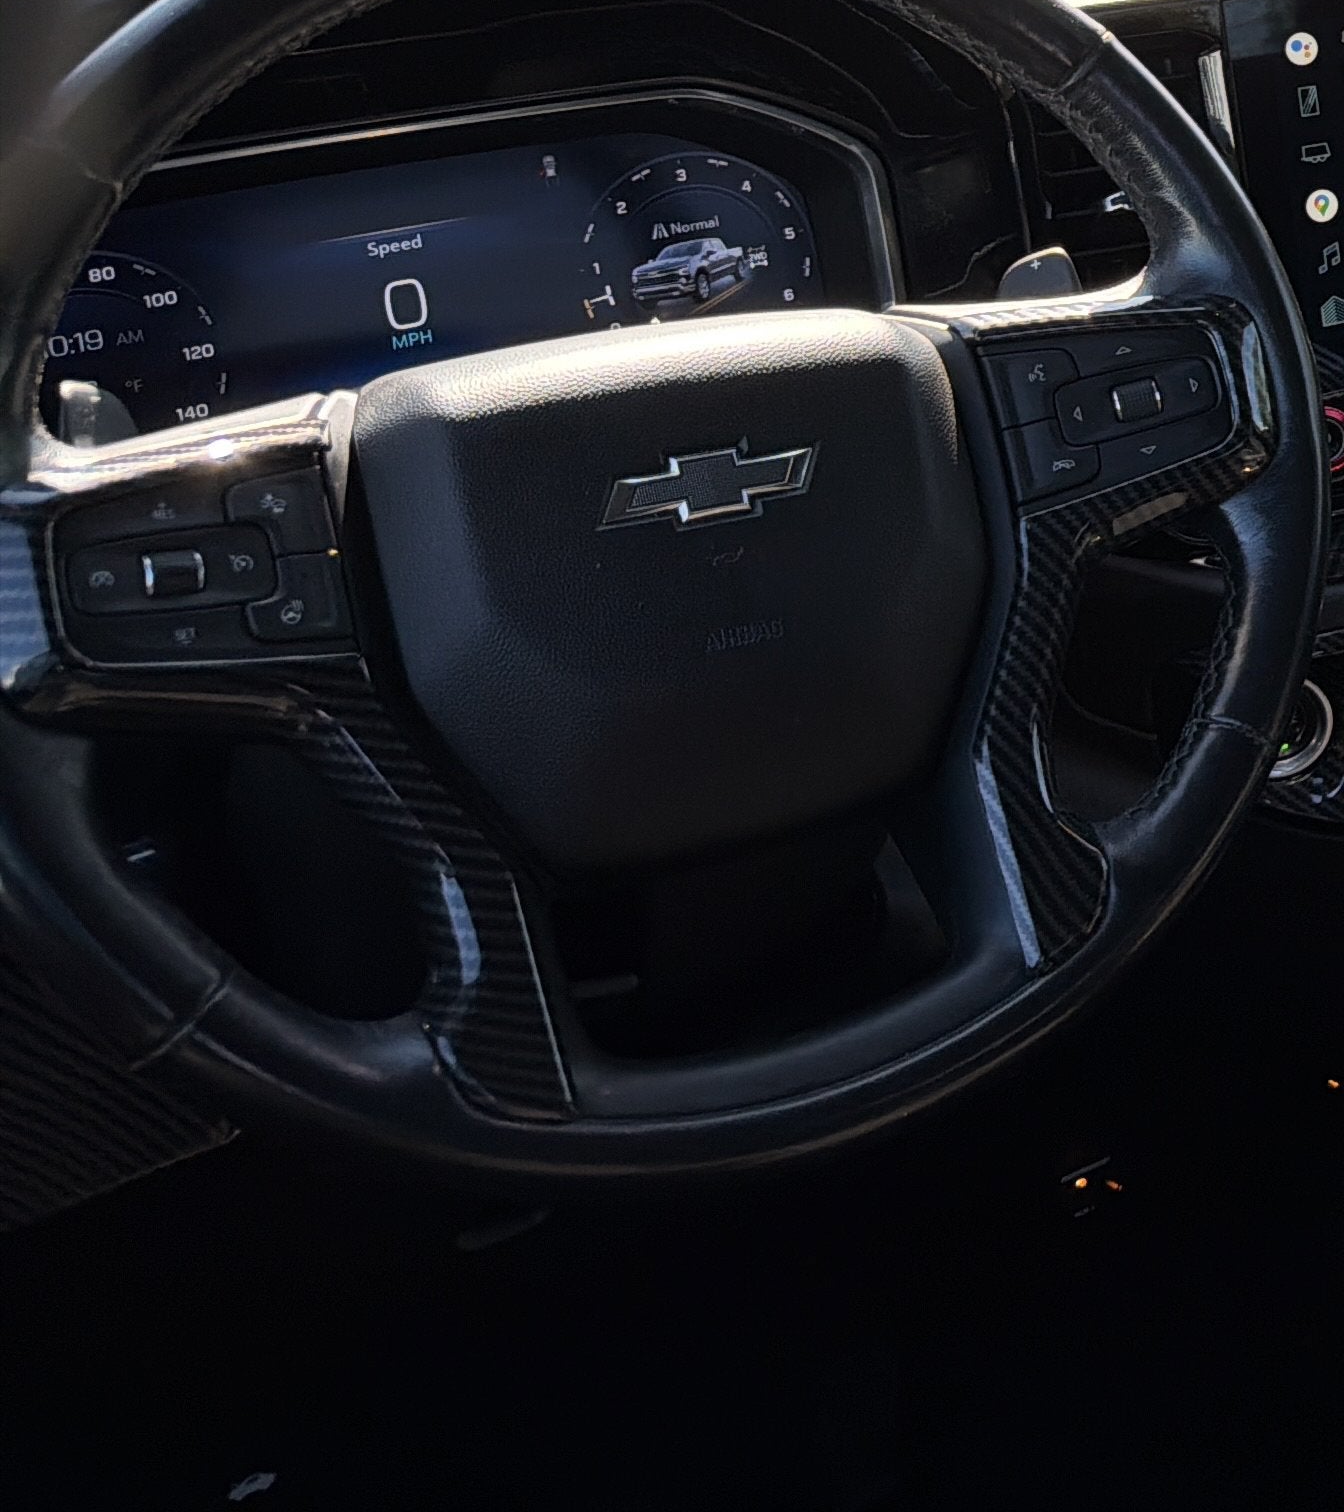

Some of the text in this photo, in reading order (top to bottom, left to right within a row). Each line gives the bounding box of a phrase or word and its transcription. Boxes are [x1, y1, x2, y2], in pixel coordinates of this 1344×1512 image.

[675, 168, 687, 182] 3
[741, 180, 752, 193] 4
[616, 201, 628, 215] 2
[669, 215, 719, 236] Normal
[784, 226, 796, 240] 5
[367, 233, 423, 259] Speed
[88, 266, 115, 283] 80
[592, 262, 601, 275] 1
[143, 290, 178, 309] 100
[783, 288, 795, 301] 6
[384, 278, 428, 330] 0
[44, 329, 145, 358] 0:19 AM
[392, 329, 433, 351] MPH
[182, 343, 215, 361] 120
[175, 403, 209, 422] 140
